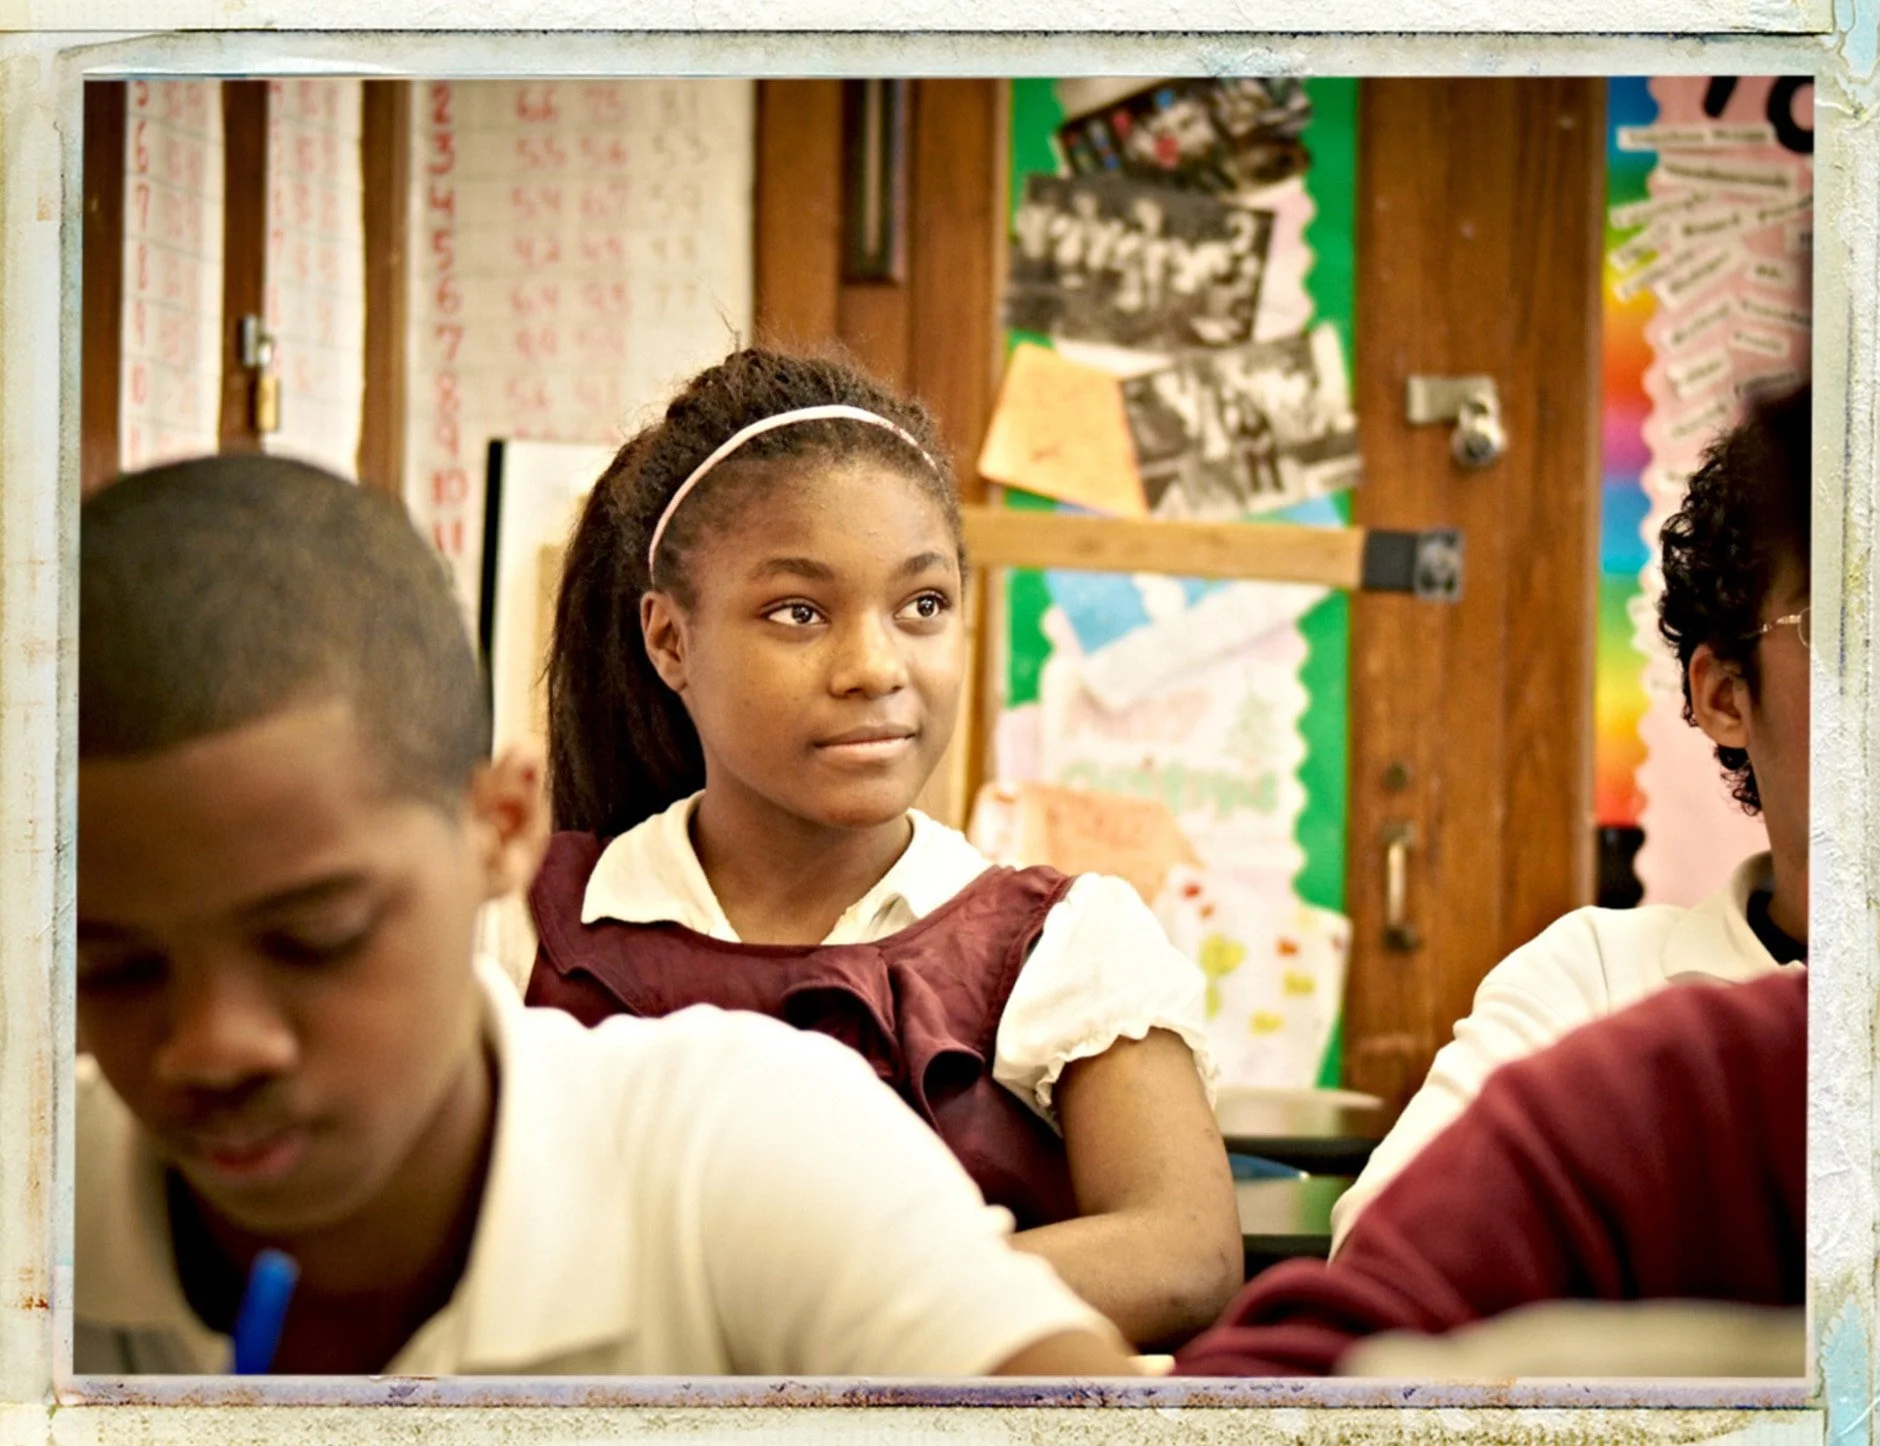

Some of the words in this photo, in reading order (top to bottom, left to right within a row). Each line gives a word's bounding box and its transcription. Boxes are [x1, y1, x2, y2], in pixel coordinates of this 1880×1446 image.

[429, 80, 454, 125] 2
[426, 131, 456, 175] 3
[429, 184, 455, 217] 4
[431, 229, 455, 271] 5
[435, 278, 463, 316] 6
[436, 325, 464, 360] 7
[432, 468, 468, 506] 10
